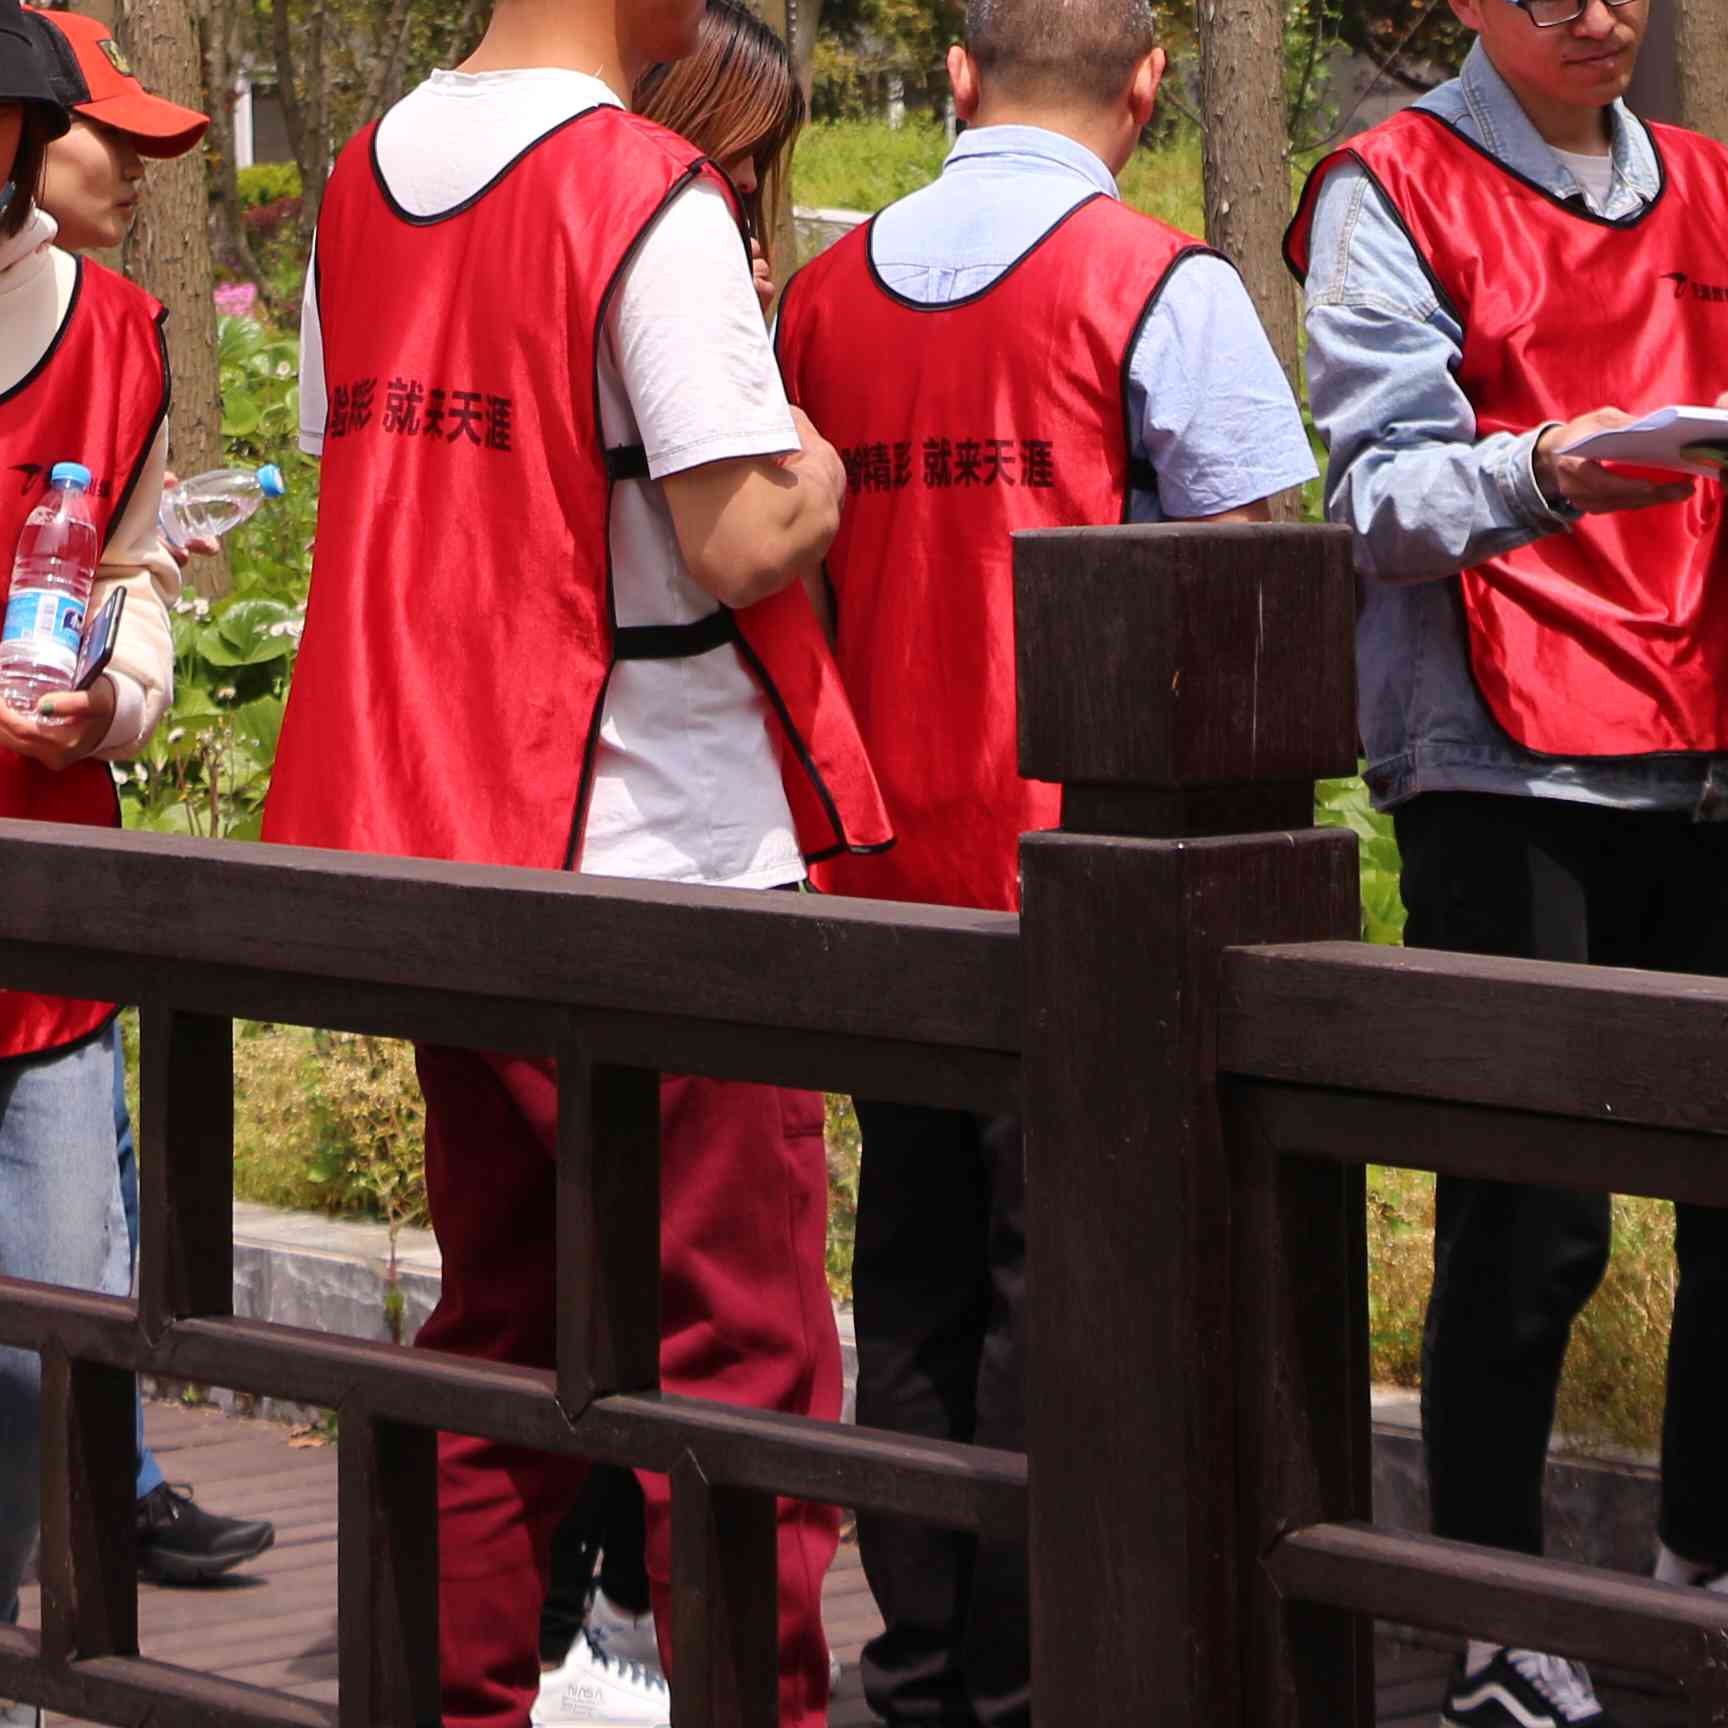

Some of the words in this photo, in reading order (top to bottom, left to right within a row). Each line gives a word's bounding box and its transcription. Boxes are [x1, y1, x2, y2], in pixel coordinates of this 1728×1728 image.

[923, 437, 1056, 489] 就来天涯
[566, 1681, 603, 1700] NASA
